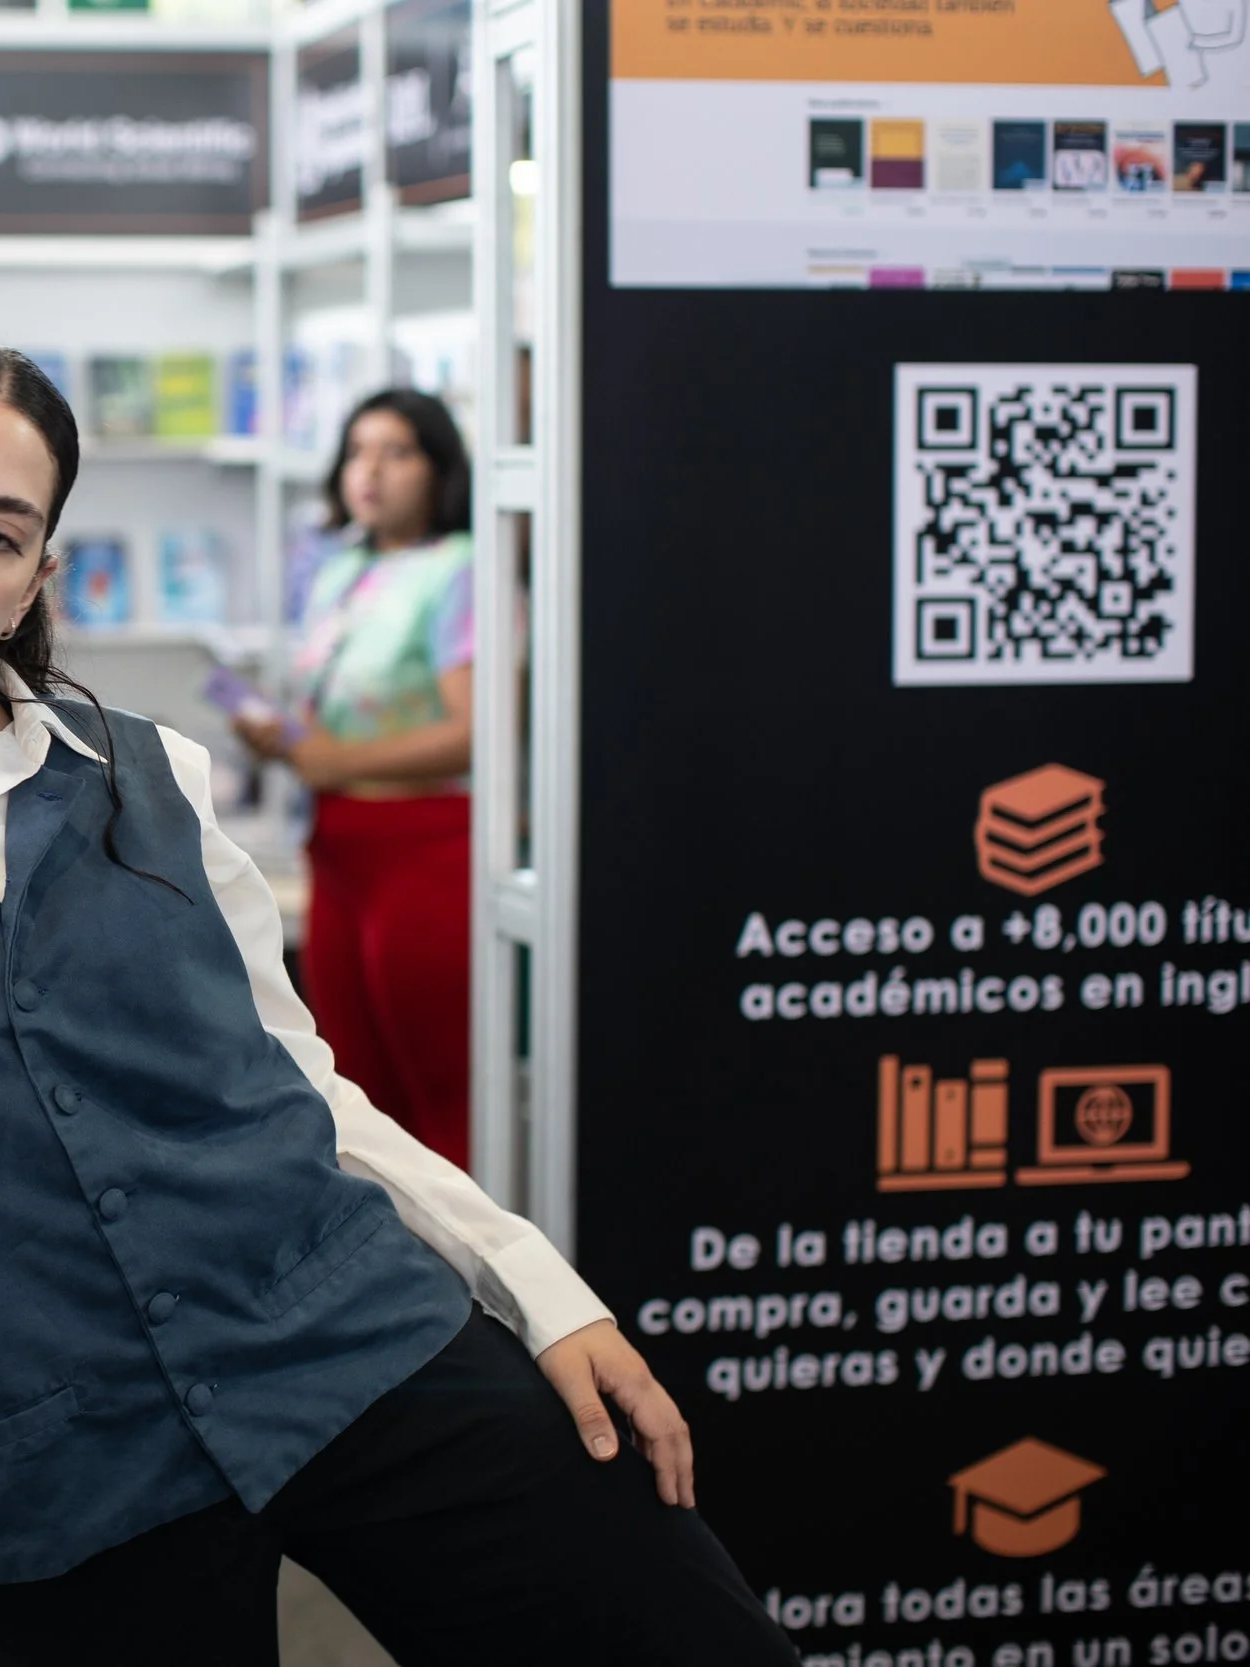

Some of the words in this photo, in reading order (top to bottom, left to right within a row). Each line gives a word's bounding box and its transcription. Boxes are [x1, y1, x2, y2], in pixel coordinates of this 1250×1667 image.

[736, 912, 934, 958] Acceso
[951, 915, 984, 952] a
[1003, 901, 1167, 952] +8,000
[740, 966, 1064, 1020] académicos
[1080, 972, 1144, 1010] en
[1161, 960, 1250, 1014] ingl
[691, 1227, 760, 1271] De
[777, 1223, 827, 1267] la
[843, 1215, 1008, 1264] tienda
[1025, 1221, 1058, 1257] a
[1075, 1211, 1122, 1254] tu
[638, 1292, 857, 1338] compra,
[875, 1274, 1060, 1334] guarda
[1077, 1280, 1108, 1322] y
[1124, 1269, 1203, 1312] lee
[707, 1346, 899, 1400] quieras
[915, 1349, 946, 1391] y
[962, 1332, 1126, 1380] donde
[1143, 1325, 1250, 1378] quie
[882, 1577, 1023, 1622] todas
[1041, 1571, 1110, 1613] las
[1129, 1563, 1250, 1608] área
[992, 1643, 1054, 1667] en
[1073, 1637, 1131, 1667] un
[1150, 1622, 1250, 1666] solo
